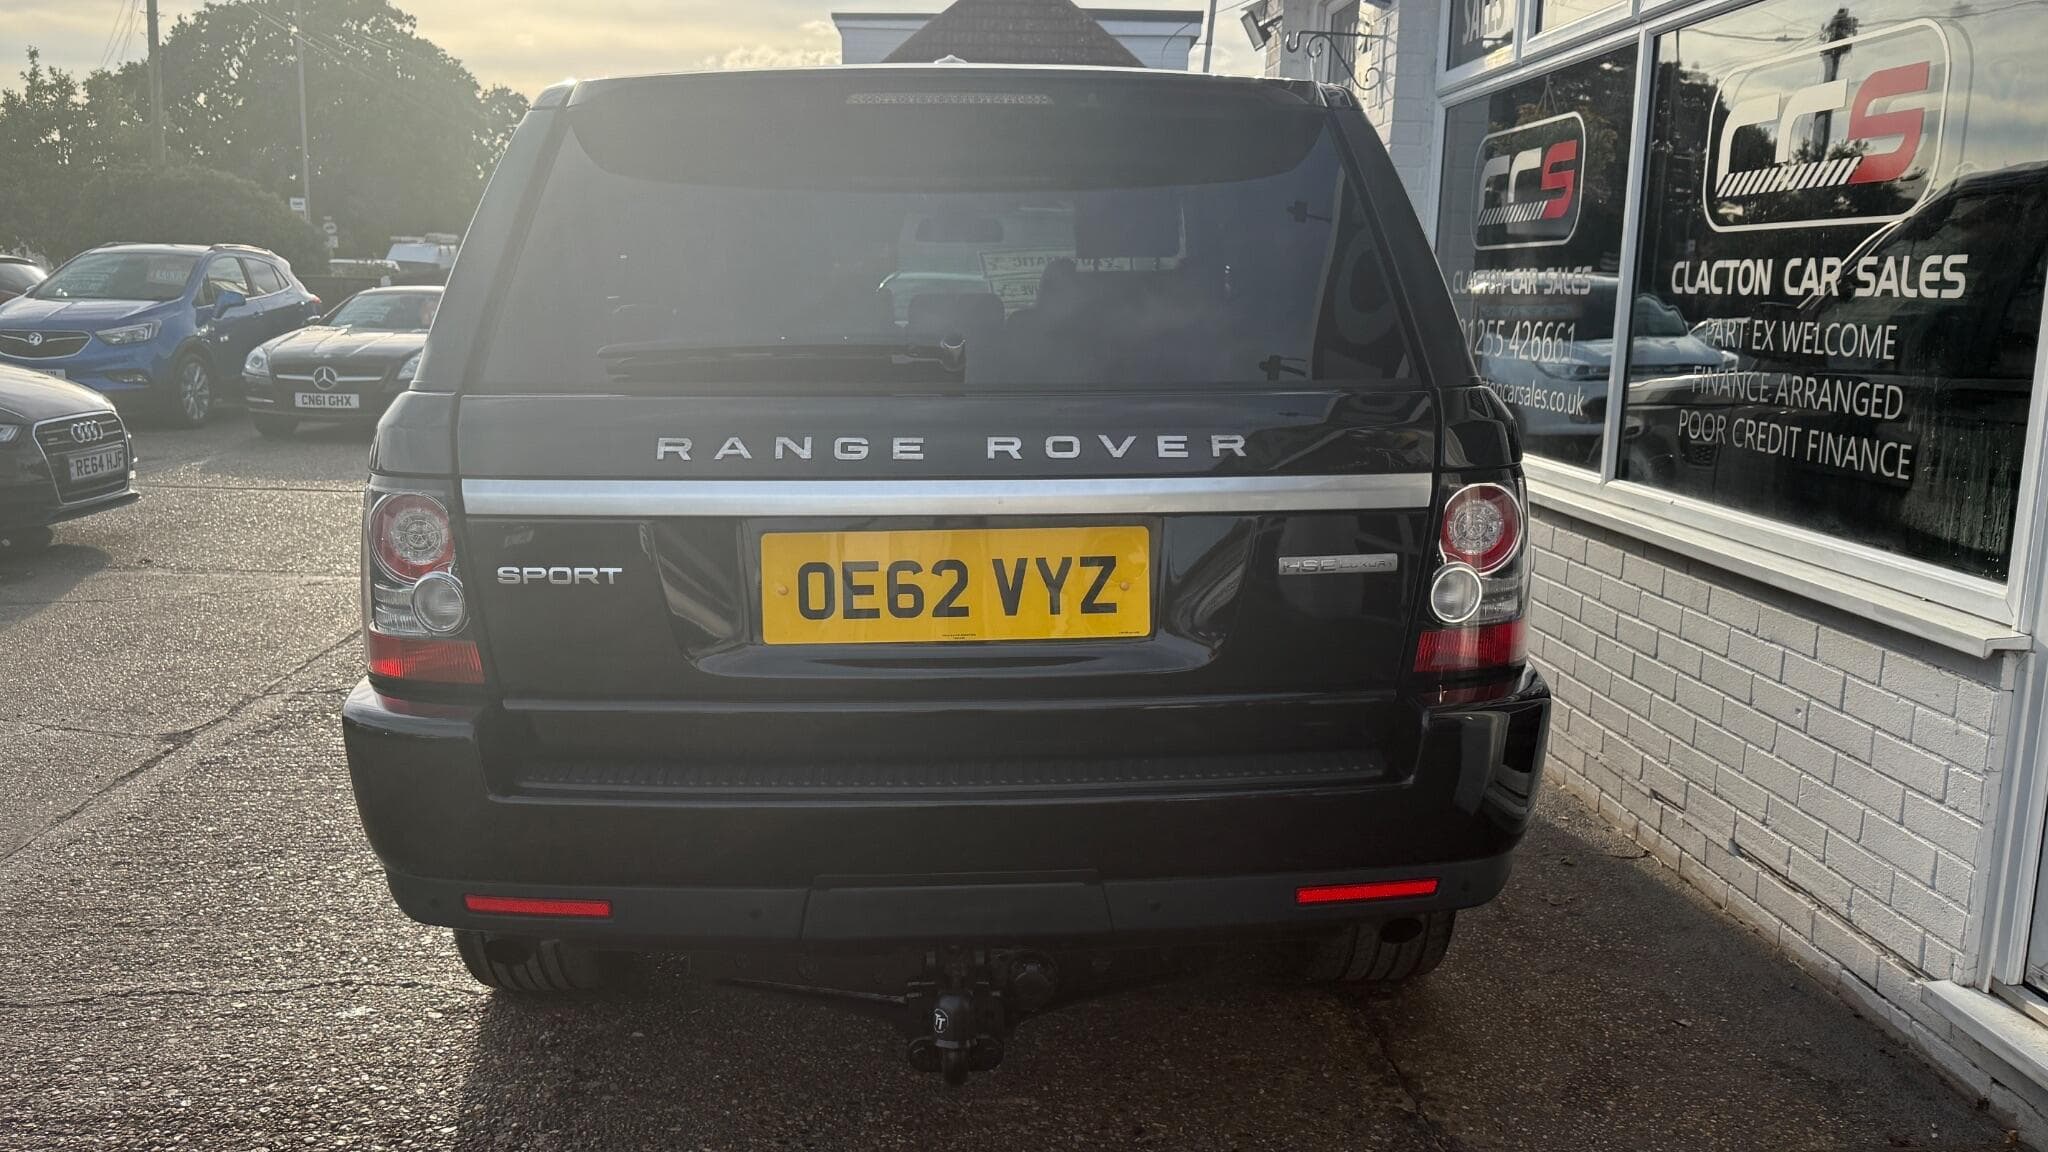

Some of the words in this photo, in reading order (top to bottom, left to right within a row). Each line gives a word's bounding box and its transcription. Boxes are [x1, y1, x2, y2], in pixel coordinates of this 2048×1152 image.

[1452, 268, 1507, 295] CLACTON
[1510, 267, 1539, 295] CAR
[1543, 266, 1593, 296] SALES
[1671, 258, 1774, 297] CLACTON
[1783, 256, 1843, 297] CAR
[1855, 254, 1969, 299] SALES
[1508, 320, 1576, 364] 426661
[1704, 317, 1748, 350] PART
[1752, 319, 1777, 352] EX
[1781, 320, 1897, 361] WELCOME
[301, 394, 326, 407] CN61
[328, 395, 352, 407] GHX
[1692, 366, 1771, 404] FINANCE
[1774, 373, 1904, 421] ARRANGED
[76, 455, 104, 477] RE64
[656, 437, 925, 461] RANGE
[986, 434, 1248, 460] ROVER
[1678, 409, 1727, 446] POOR
[1732, 417, 1802, 459] CREDIT
[1806, 430, 1912, 481] FINANCE
[497, 567, 623, 584] SPORT
[797, 558, 970, 620] OE62
[992, 556, 1118, 616] VYZ
